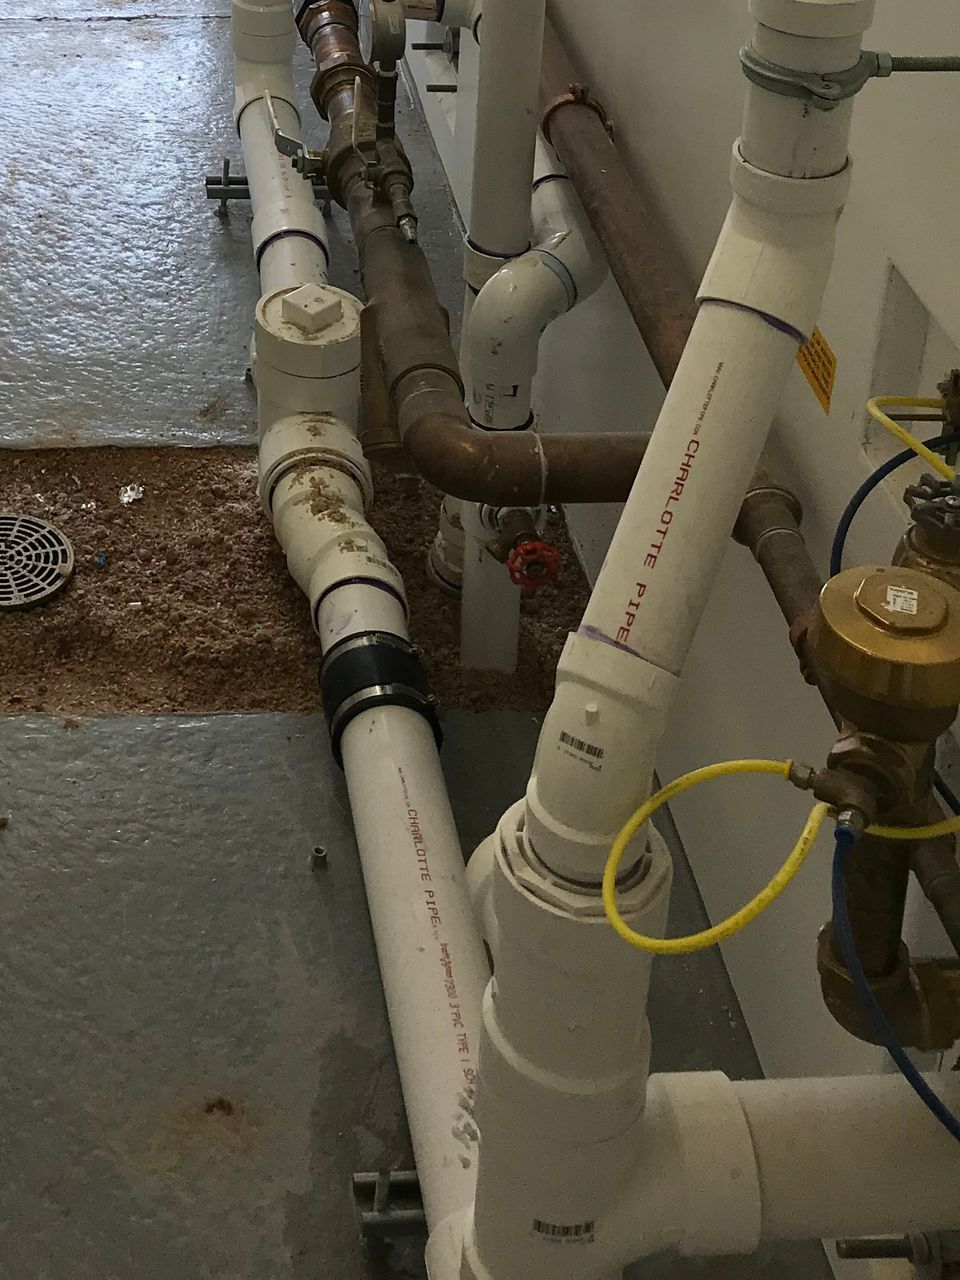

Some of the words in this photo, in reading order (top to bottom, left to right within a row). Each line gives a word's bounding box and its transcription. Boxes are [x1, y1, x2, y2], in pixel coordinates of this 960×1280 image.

[643, 438, 700, 570] CHARLOTTE
[615, 581, 647, 644] PIPE
[408, 808, 432, 882] CHARLOTTE
[424, 889, 442, 927] PIPE
